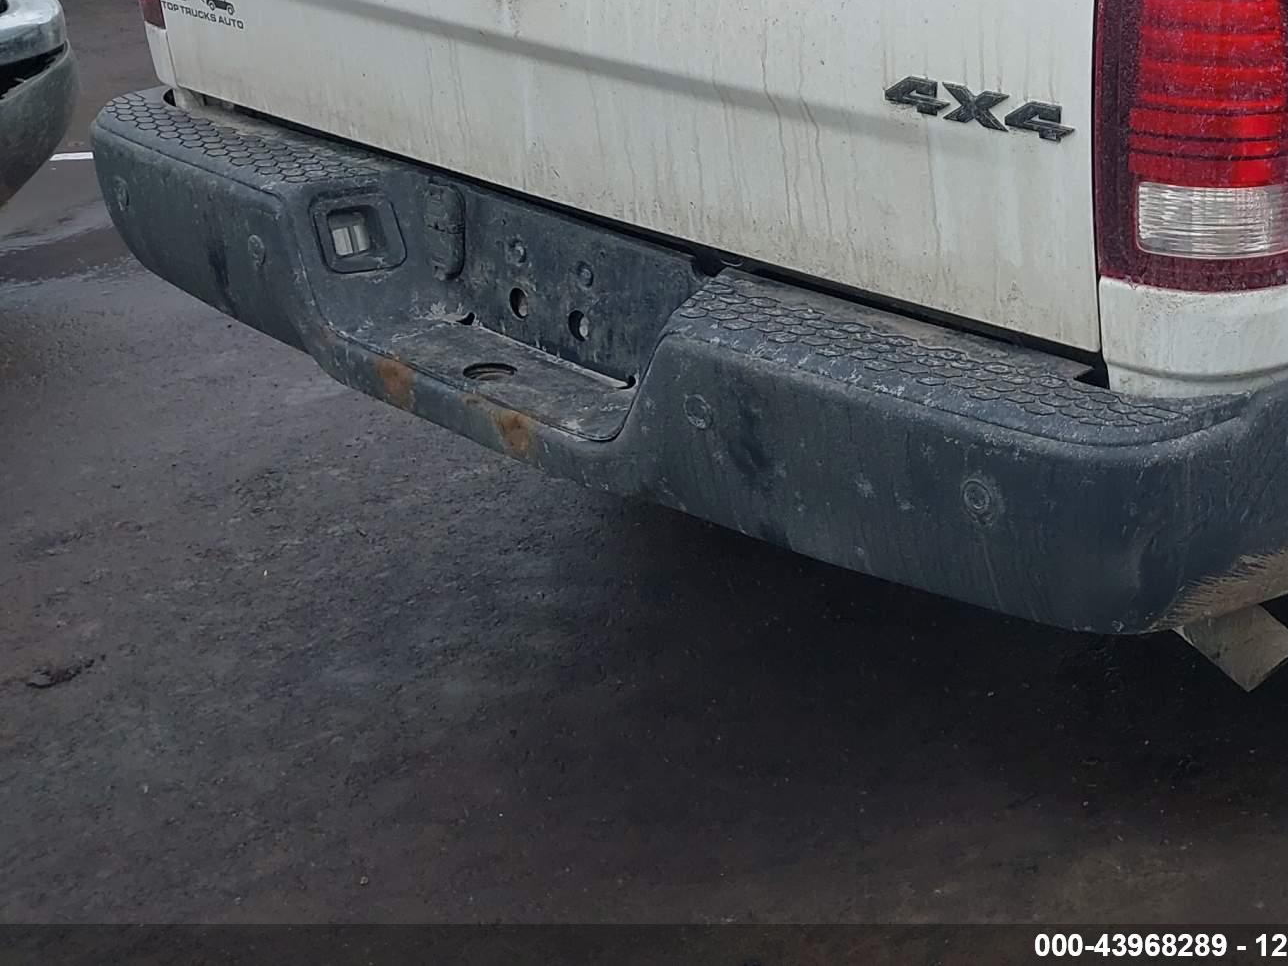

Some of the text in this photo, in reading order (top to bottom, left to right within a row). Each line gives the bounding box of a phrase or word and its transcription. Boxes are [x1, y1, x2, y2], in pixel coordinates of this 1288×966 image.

[161, 0, 244, 29] TOP TRUCKS AUTO
